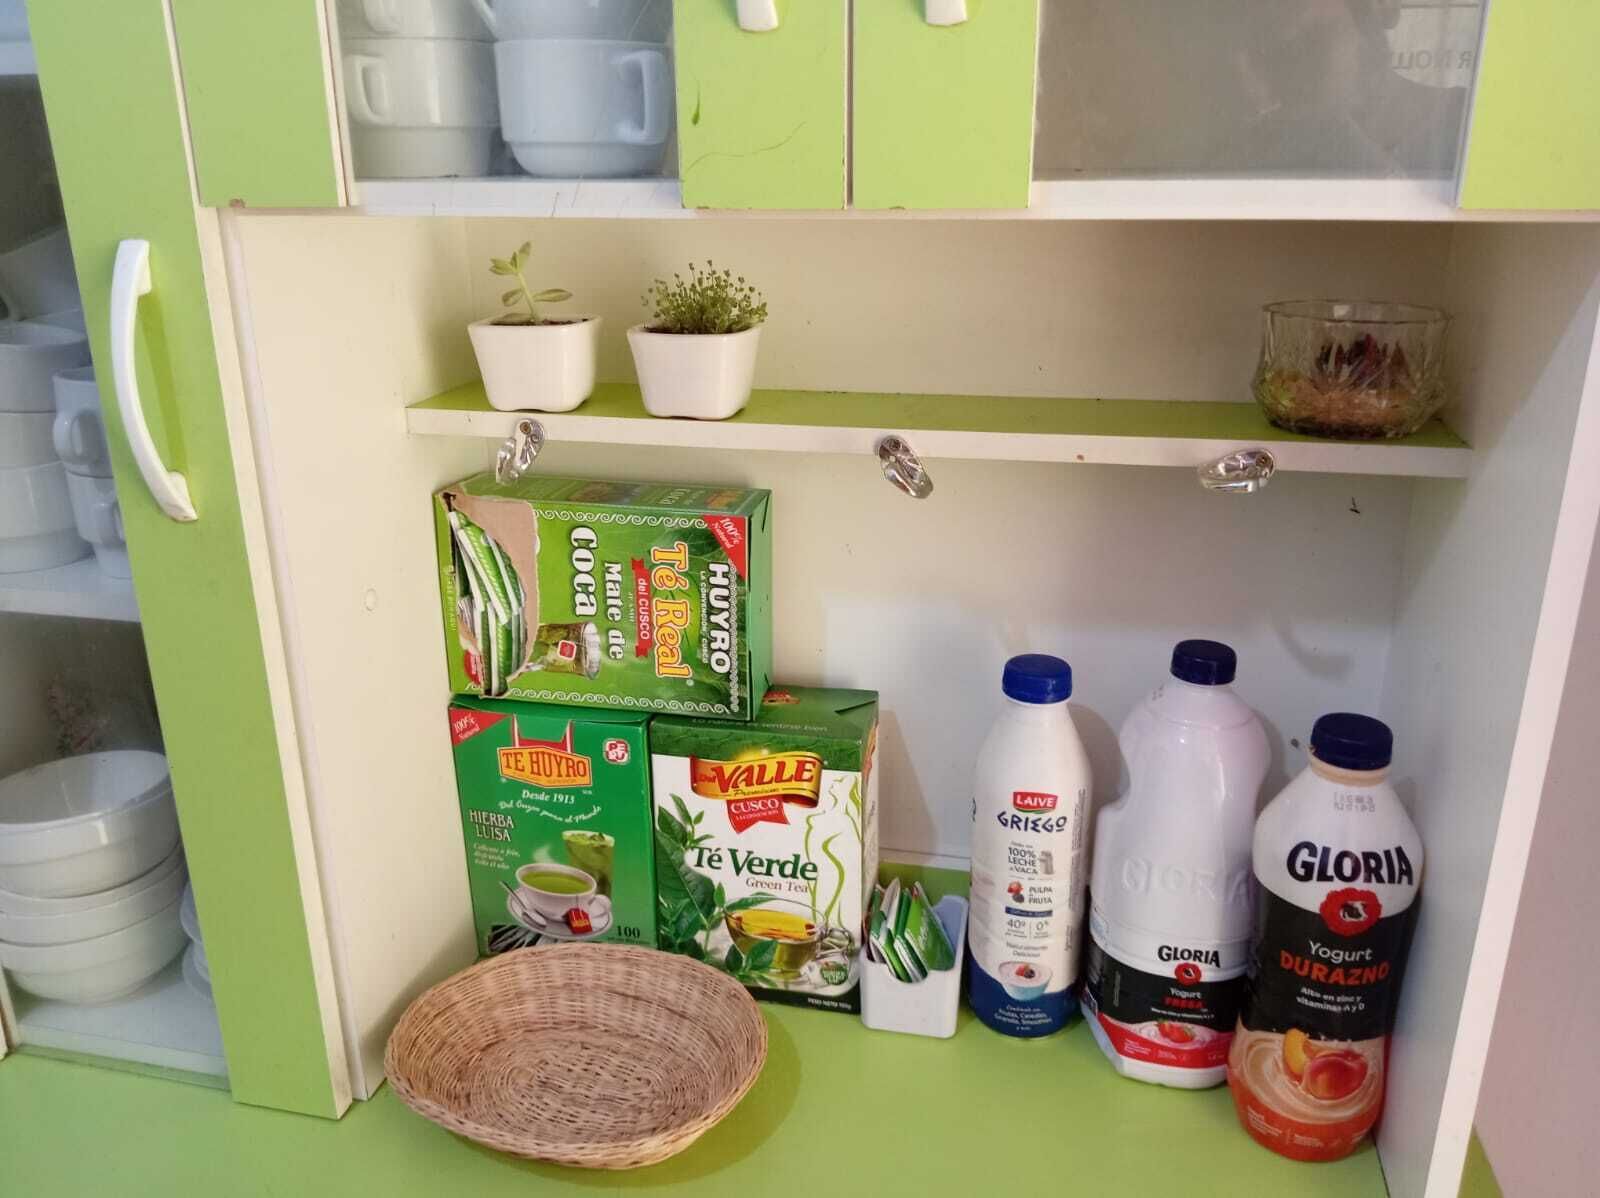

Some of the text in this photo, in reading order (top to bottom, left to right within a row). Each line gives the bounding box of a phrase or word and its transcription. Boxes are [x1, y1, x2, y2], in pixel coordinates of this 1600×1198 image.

[719, 517, 744, 545] 100%
[603, 561, 627, 660] Mate de
[637, 577, 651, 641] del CUSCO
[650, 541, 694, 679] Té Real
[707, 561, 732, 675] HUYRO
[501, 751, 588, 778] TE HUYRO
[712, 759, 817, 793] VALLE
[521, 789, 551, 802] Desde
[1016, 794, 1054, 808] LAIVE
[731, 798, 780, 814] CUSCO
[469, 809, 515, 829] HIERBA
[997, 810, 1068, 834] GRIEGO
[475, 824, 512, 842] LUISA
[1008, 847, 1037, 859] 100%
[1008, 856, 1037, 868] LECHE
[689, 846, 818, 881] Té Verde
[1014, 865, 1039, 875] VACA
[1286, 841, 1414, 886] GLORIA
[745, 877, 808, 893] Green Tea
[1028, 886, 1053, 895] PULPA
[1028, 897, 1053, 905] FRUTA
[617, 925, 641, 940] 100
[1157, 944, 1221, 969] GLORIA
[1308, 939, 1374, 964] Yogurt
[1279, 949, 1391, 986] DURAZNO
[1169, 986, 1202, 999] Yogurt
[1300, 987, 1321, 998] Alto
[1322, 992, 1335, 1001] en
